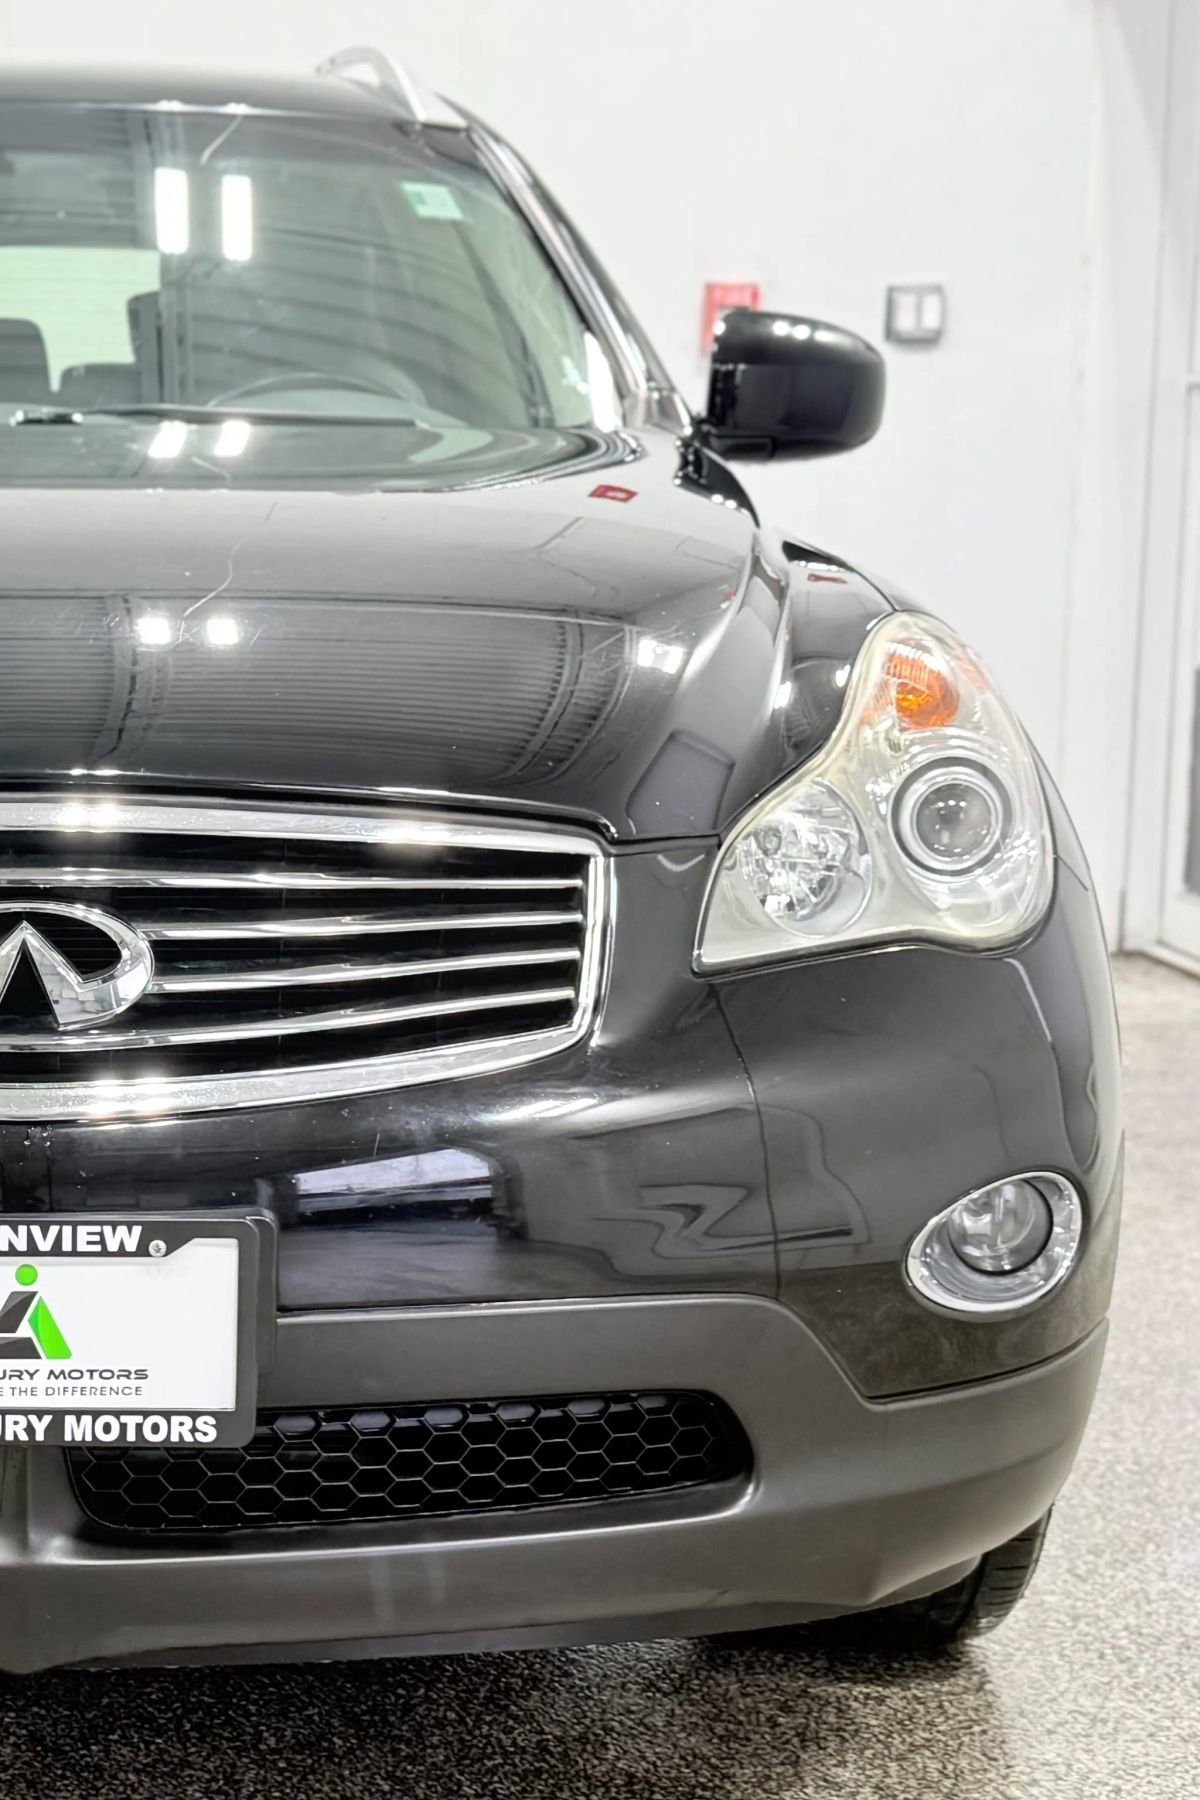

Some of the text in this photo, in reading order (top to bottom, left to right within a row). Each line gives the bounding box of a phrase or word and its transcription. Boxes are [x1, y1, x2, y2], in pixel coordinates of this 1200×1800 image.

[46, 1368, 149, 1381] MOTORS
[9, 1386, 39, 1397] THE
[44, 1386, 143, 1397] DIFFERENCE
[64, 1414, 218, 1443] MOTORS
